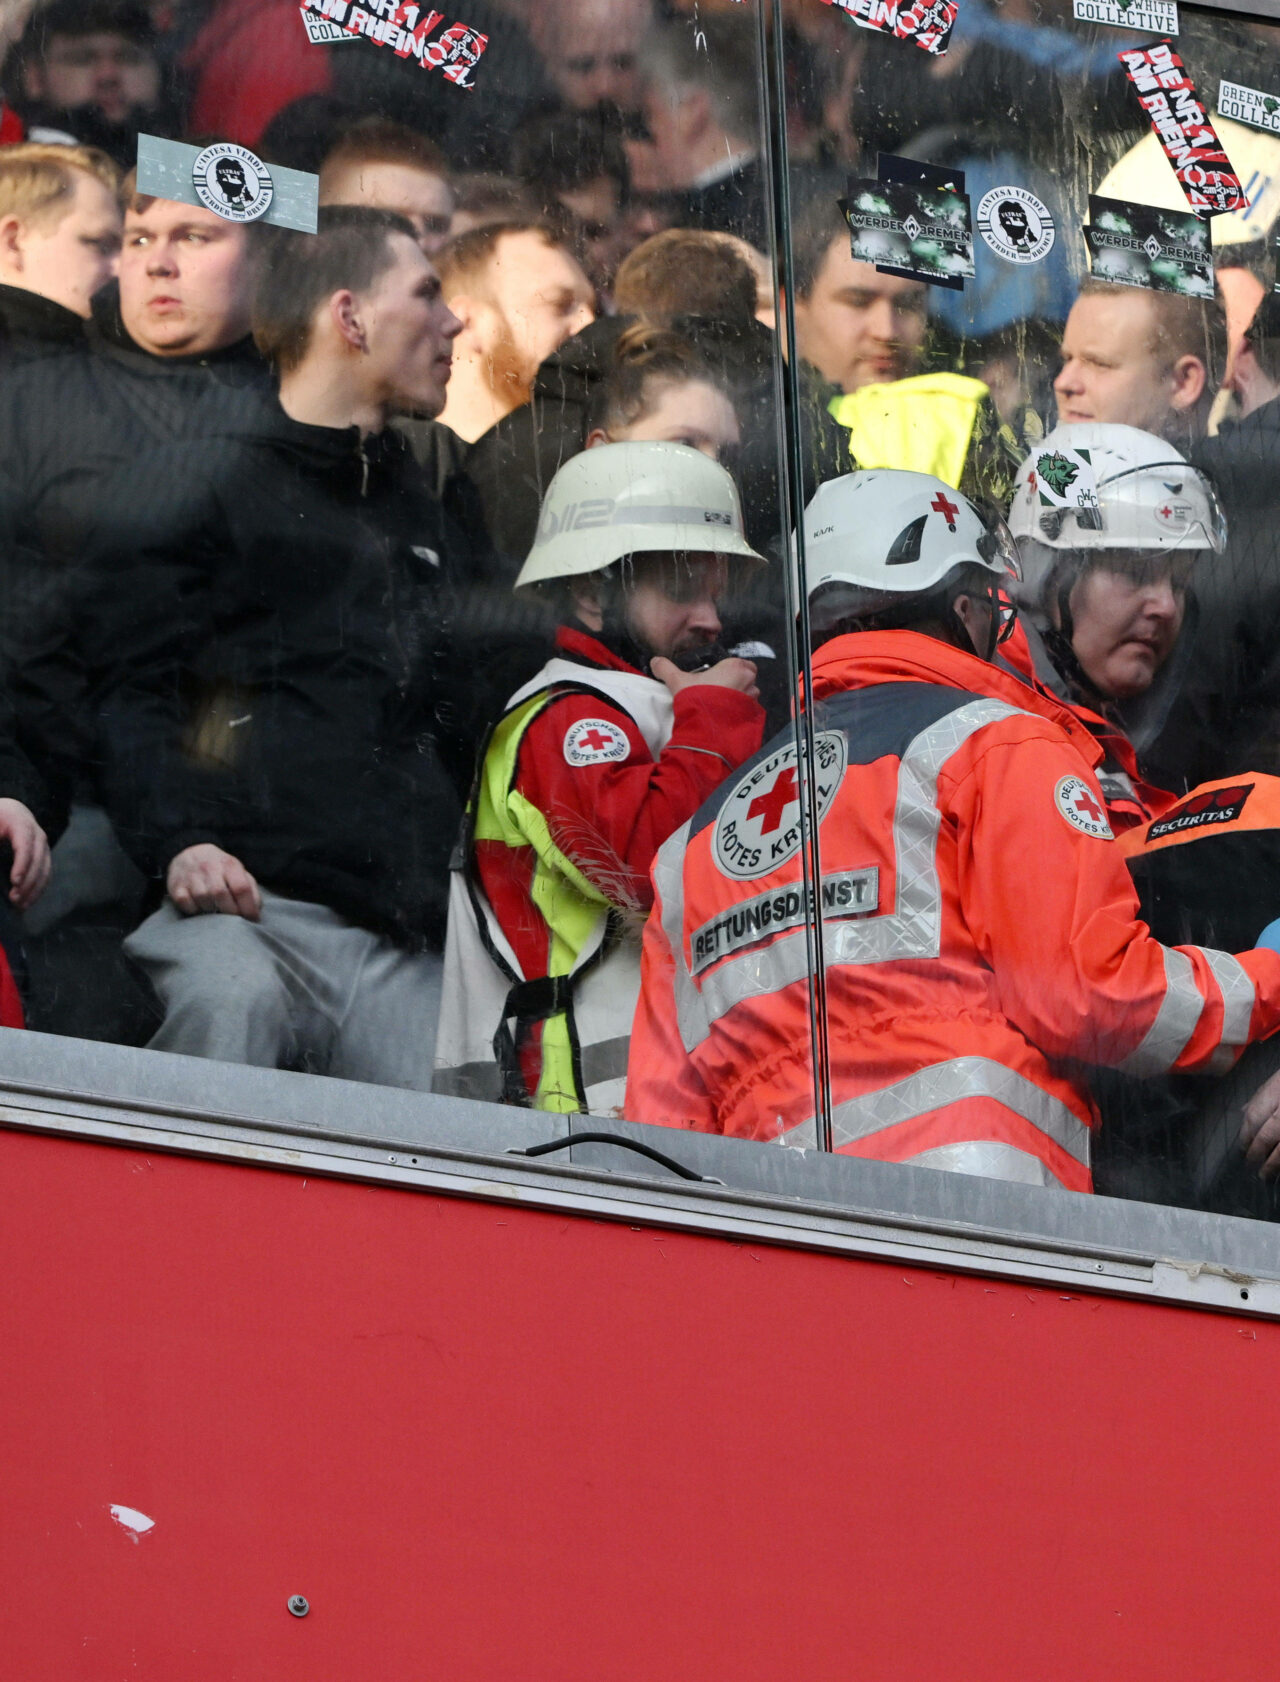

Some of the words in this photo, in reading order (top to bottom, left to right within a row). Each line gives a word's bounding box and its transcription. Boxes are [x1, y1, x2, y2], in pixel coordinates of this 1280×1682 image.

[1077, 2, 1175, 32] COLLECTIVE
[1135, 1, 1174, 15] WHITE
[348, 6, 426, 59] RHEIN
[1122, 52, 1160, 93] AM
[1142, 91, 1199, 168] RHEIN
[1148, 45, 1184, 88] DIE
[1170, 87, 1214, 148] NR.1
[1222, 85, 1262, 107] GREEN
[196, 145, 232, 171] L'INTESA
[236, 148, 265, 174] VERDE
[201, 189, 231, 217] WERDER
[246, 192, 269, 217] BREMEN
[980, 189, 1012, 216] L'INTESA
[1015, 189, 1045, 214] VERDE
[850, 213, 904, 232] WERDER
[920, 227, 972, 244] BREMEN
[987, 234, 1017, 259] WERDER
[1031, 231, 1051, 258] BREMEN
[1091, 231, 1144, 253] WERDER
[1160, 245, 1213, 266] BREMEN
[1077, 488, 1098, 508] GWC
[567, 721, 620, 747] DEUTSCHES
[602, 741, 625, 759] KREUZ
[1066, 807, 1098, 833] ROTES
[1151, 807, 1235, 837] SECURITAS
[722, 820, 762, 868] ROTES
